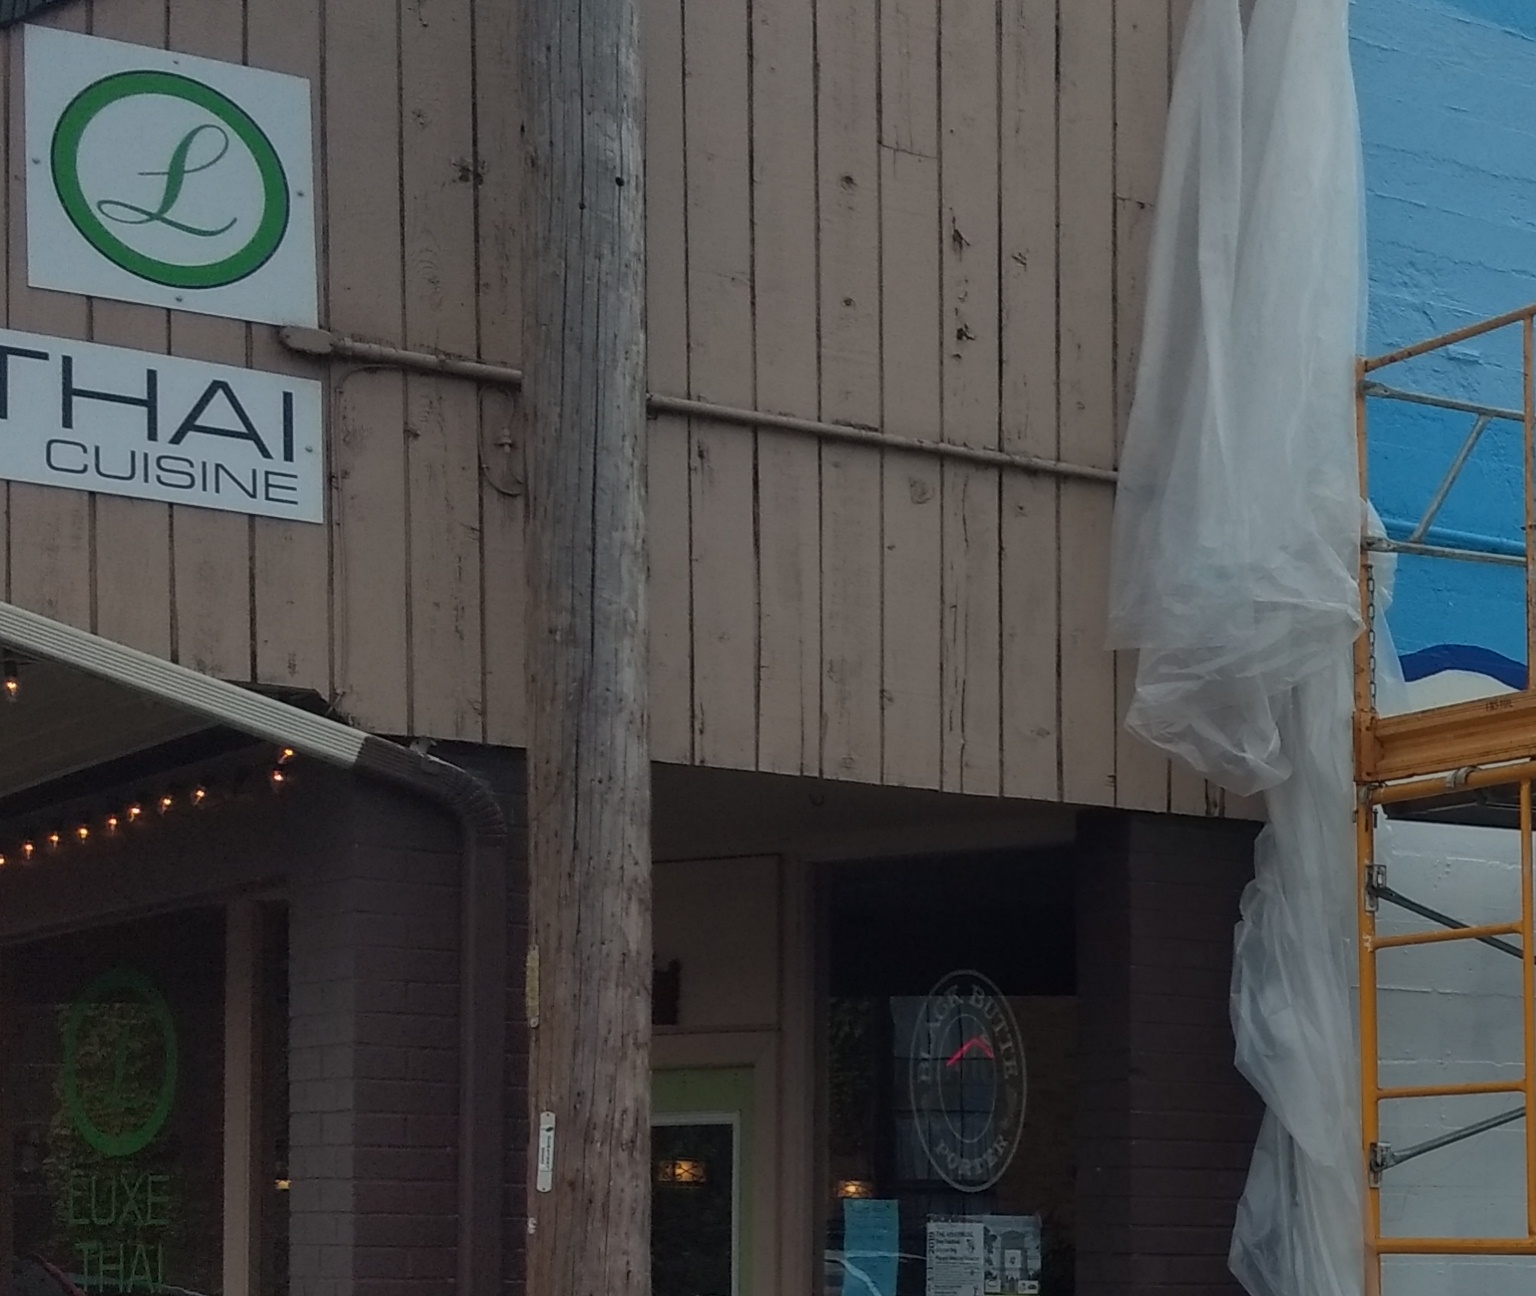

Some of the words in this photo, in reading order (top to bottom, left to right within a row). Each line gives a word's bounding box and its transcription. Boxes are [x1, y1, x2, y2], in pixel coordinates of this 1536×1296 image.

[97, 124, 237, 236] L
[0, 344, 294, 463] THAI
[46, 438, 298, 505] CUISINE
[968, 984, 1019, 1080] BUTTE
[935, 1133, 1010, 1177] PORTER
[74, 1242, 166, 1295] THAI
